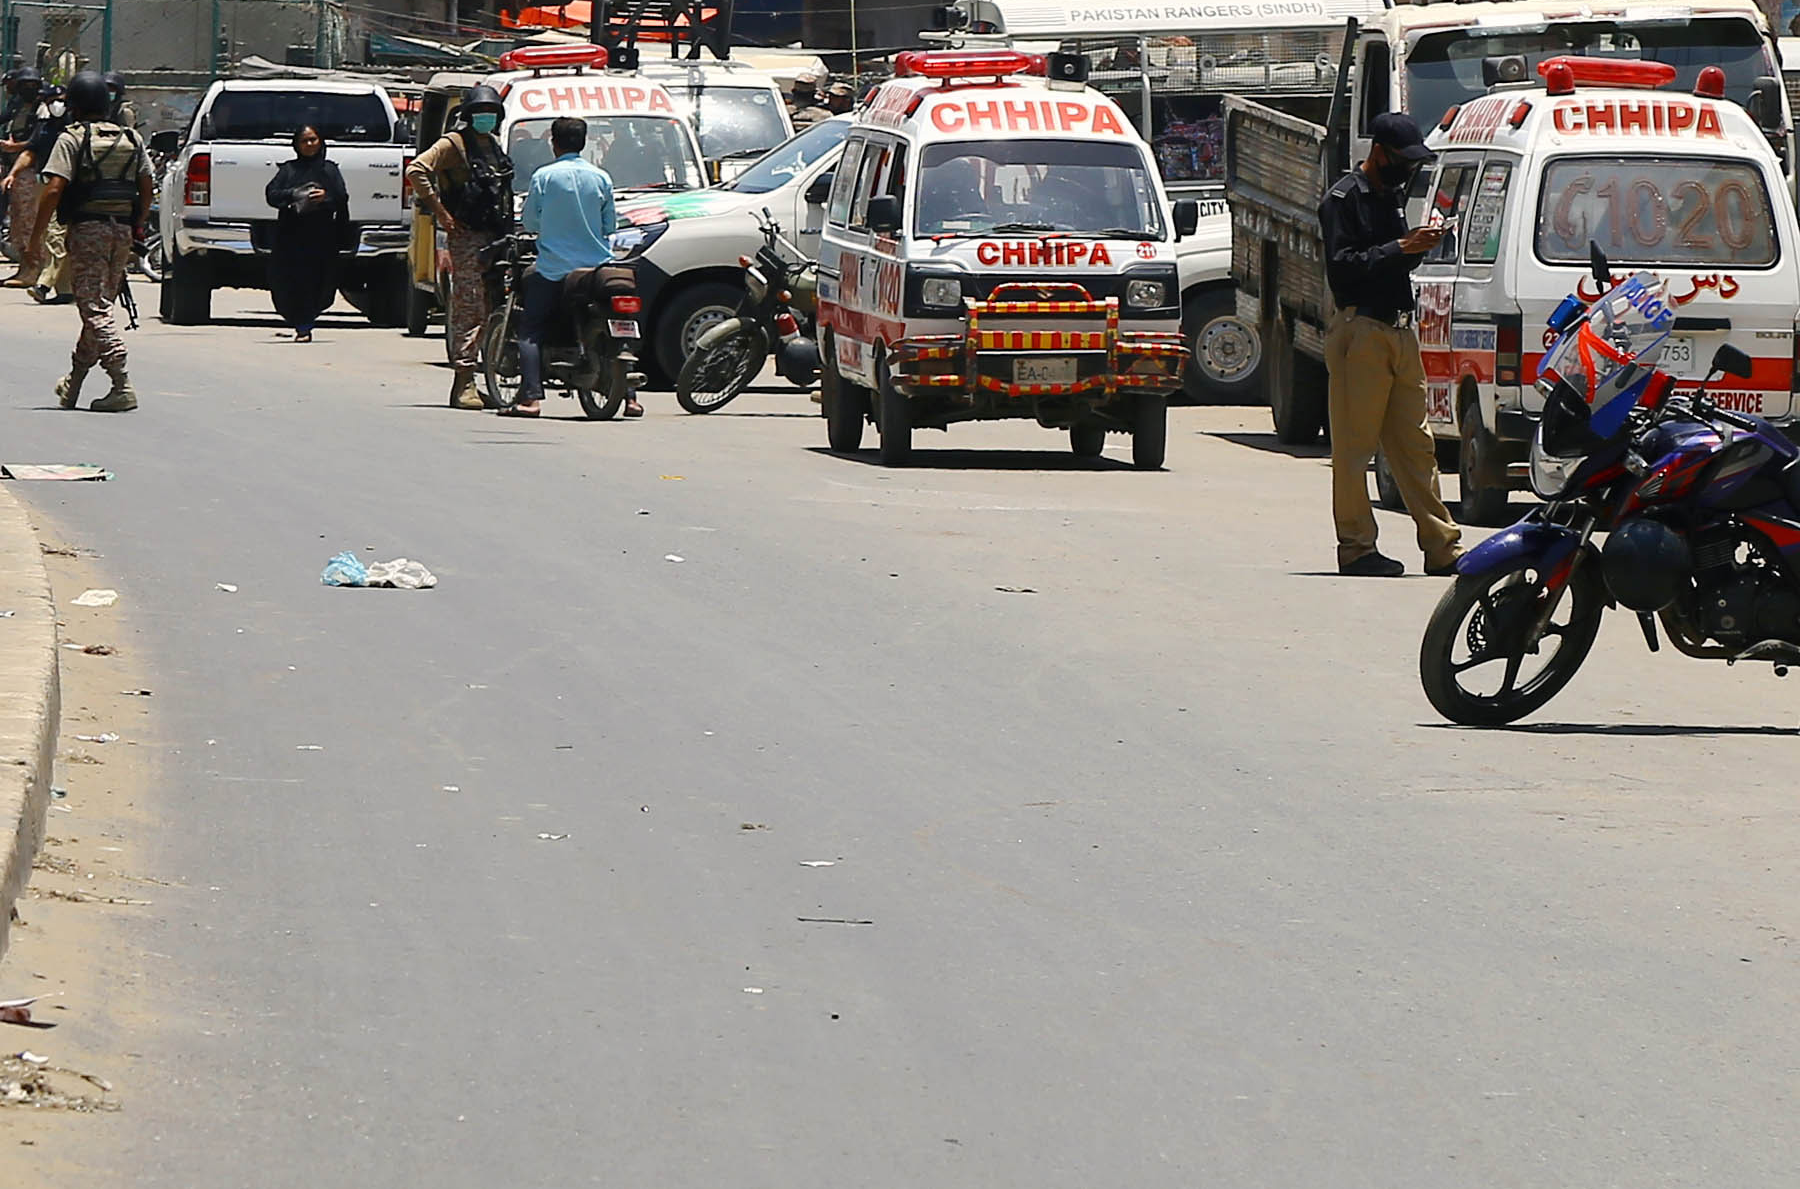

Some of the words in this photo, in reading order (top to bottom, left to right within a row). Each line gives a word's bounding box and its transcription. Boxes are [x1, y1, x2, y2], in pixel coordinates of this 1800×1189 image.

[1070, 9, 1161, 23] PAKISTAN
[1165, 4, 1254, 19] RANGERS
[1257, 2, 1324, 17] (SINDH)
[519, 86, 673, 113] CHHIPA
[931, 100, 1126, 135] CHHIPA
[1553, 99, 1727, 140] CHHIPA
[1200, 201, 1226, 218] CITY
[1597, 176, 1753, 250] 1020
[977, 241, 1112, 267] CHHIPA
[1137, 245, 1156, 258] 211
[1624, 277, 1673, 330] POLICE
[1711, 392, 1763, 413] SERVICE
